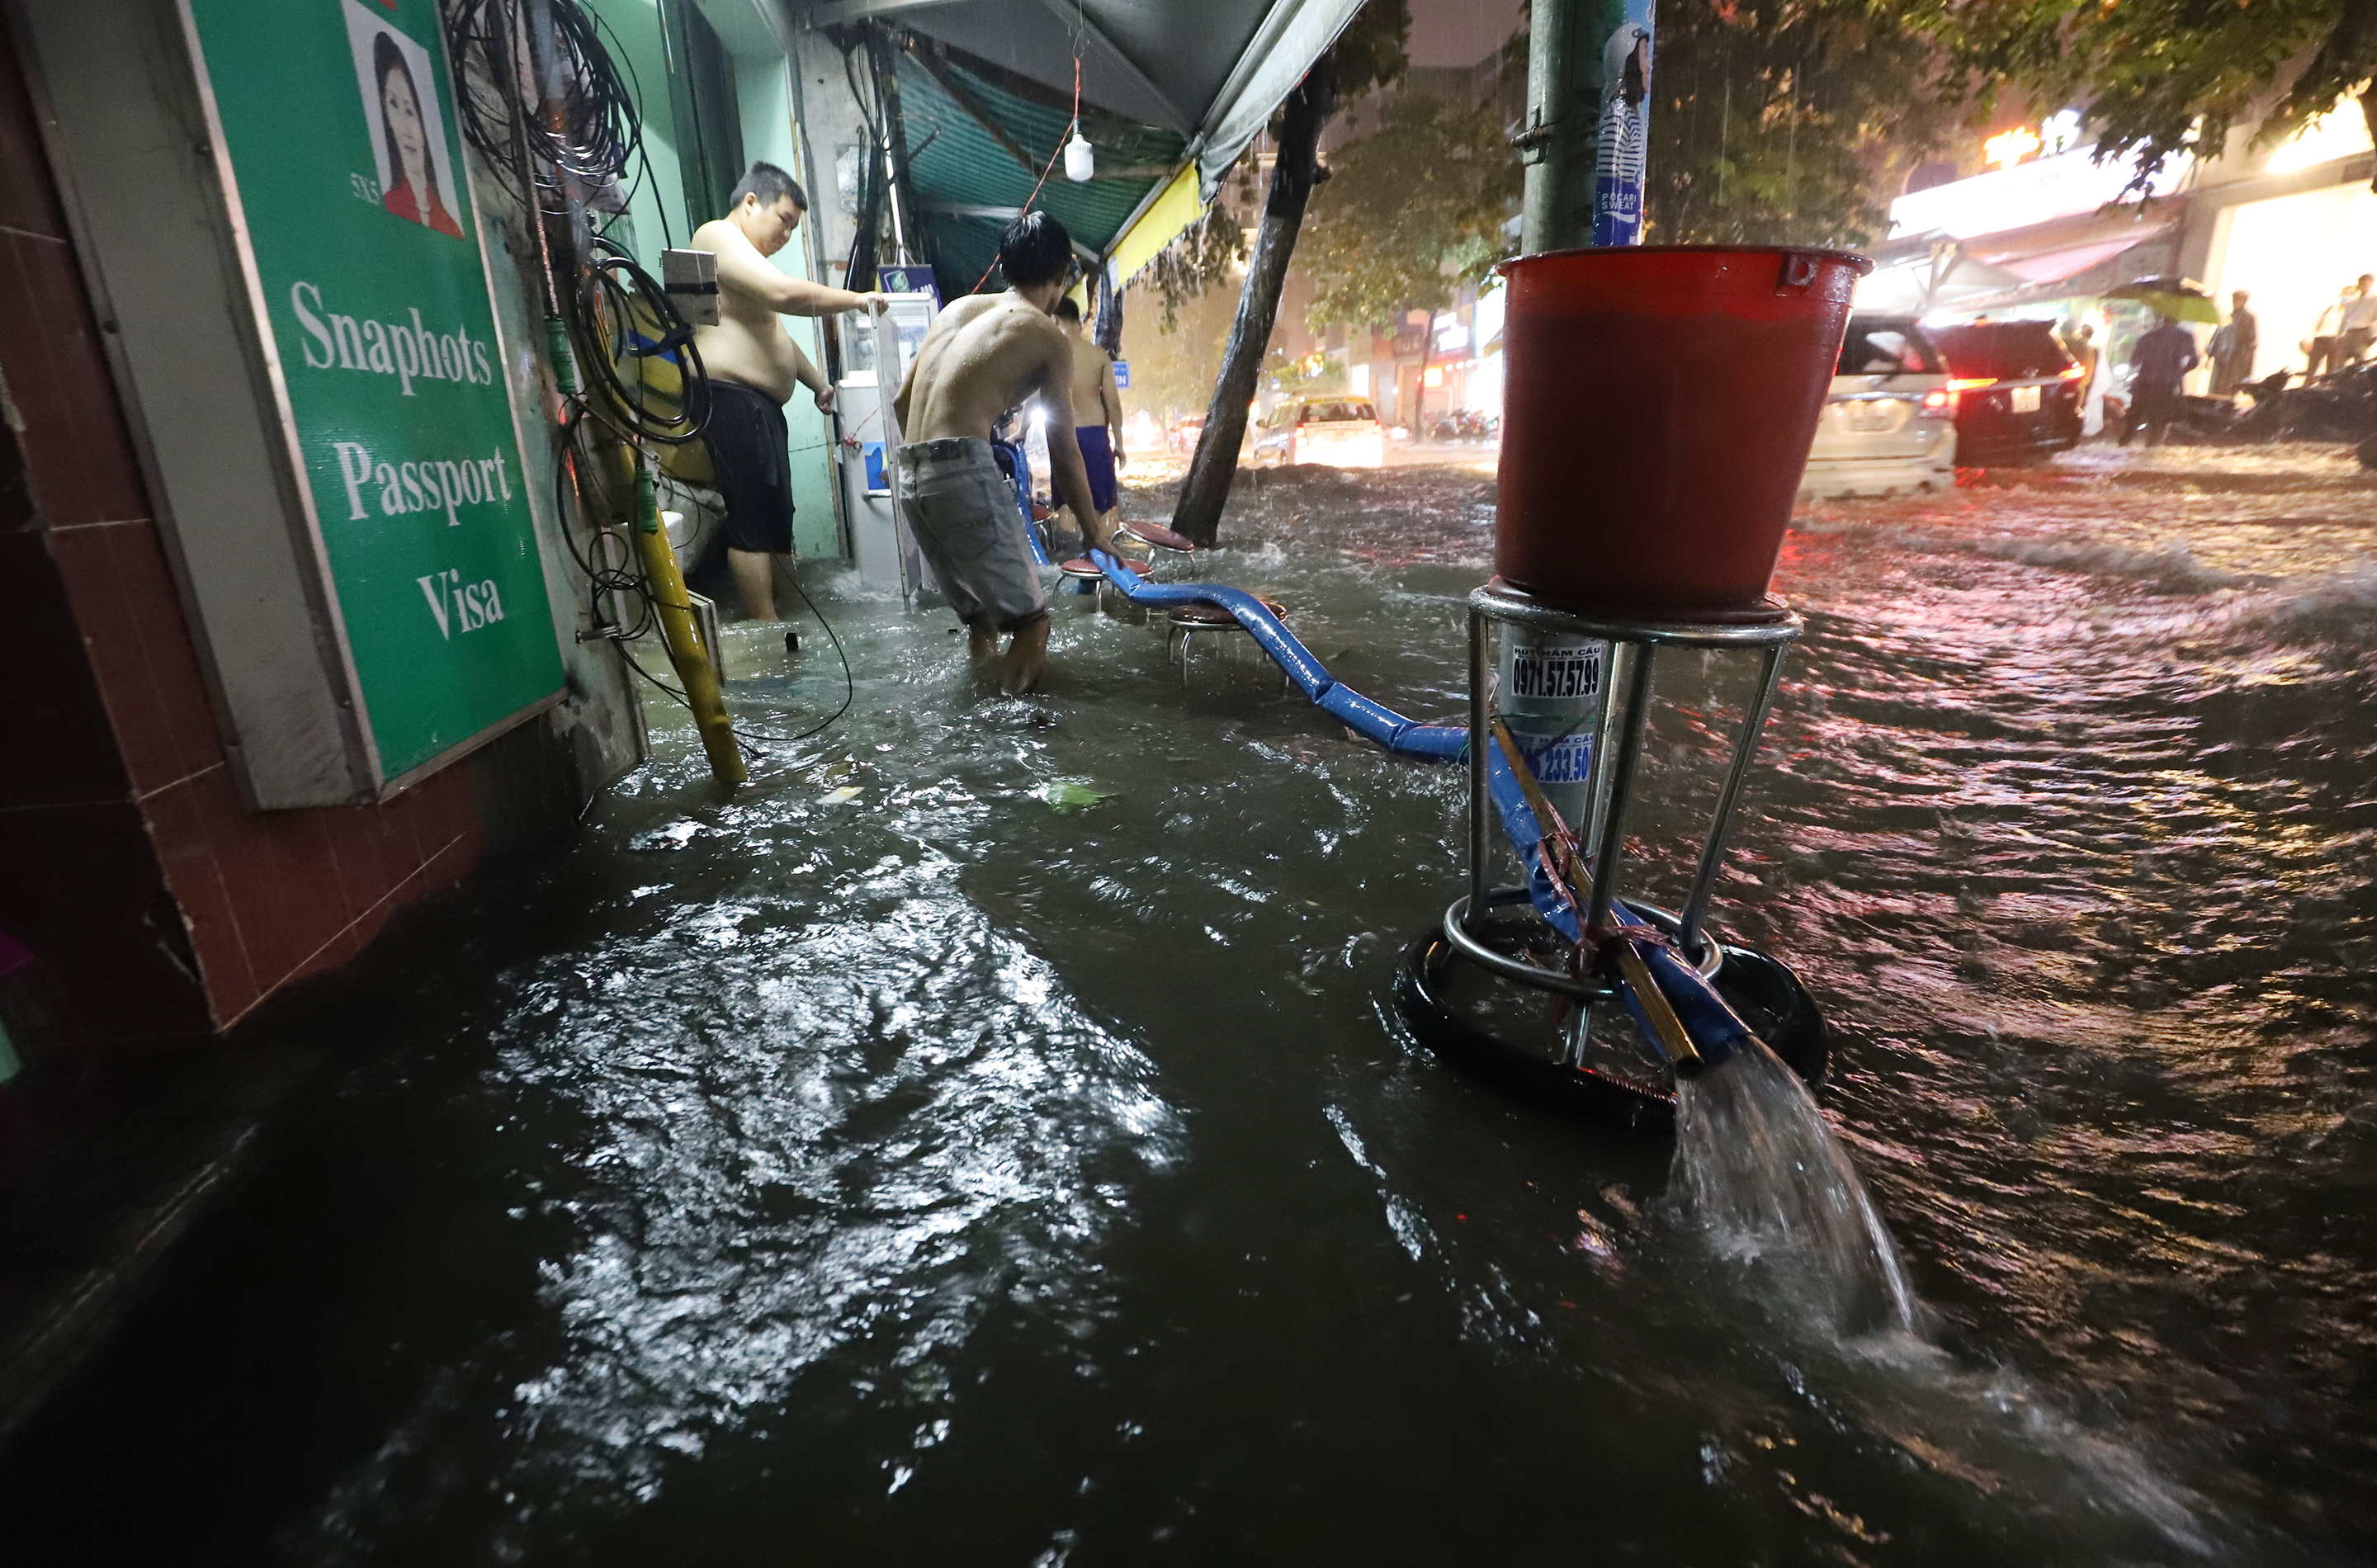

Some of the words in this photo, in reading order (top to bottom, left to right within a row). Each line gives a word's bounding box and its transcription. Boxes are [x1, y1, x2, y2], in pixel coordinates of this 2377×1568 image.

[1601, 201, 1634, 210] SWEAT
[1602, 192, 1637, 203] POCARI
[291, 281, 492, 396] Snaphots
[333, 442, 511, 527] Passport
[417, 568, 504, 641] Visa
[1514, 658, 1600, 697] 0971.57.57.99
